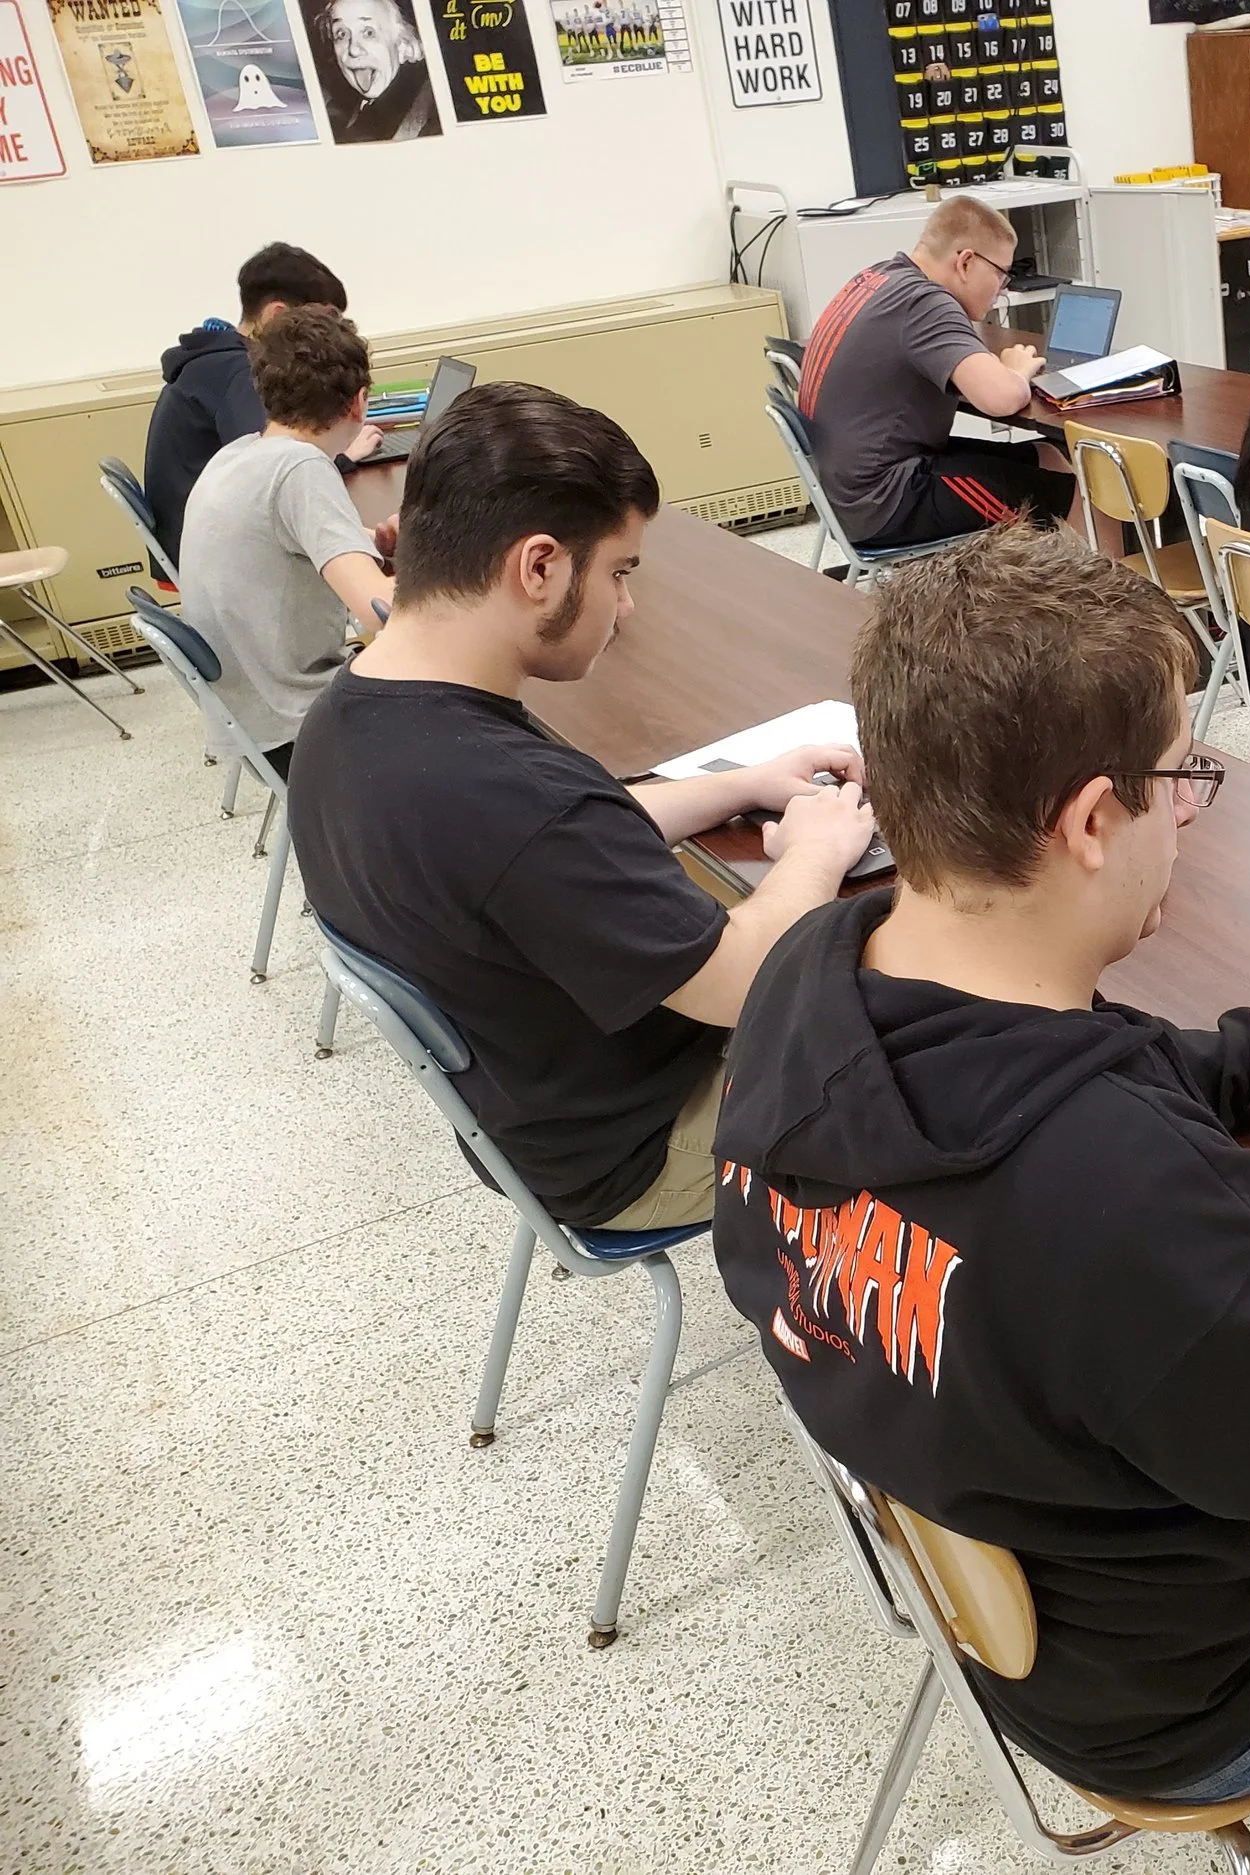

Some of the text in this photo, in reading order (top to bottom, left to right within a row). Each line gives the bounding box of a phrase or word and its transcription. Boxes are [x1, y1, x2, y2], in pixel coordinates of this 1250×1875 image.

[67, 0, 142, 21] WANTED
[730, 0, 798, 27] WITH
[895, 2, 911, 18] 07
[734, 31, 803, 61] HARD
[901, 48, 916, 65] 13
[929, 44, 945, 62] 14
[957, 42, 971, 59] 15
[984, 40, 999, 57] 16
[1038, 35, 1053, 51] 18
[473, 52, 506, 72] BE
[464, 72, 524, 95] WITH
[736, 63, 812, 94] WORK
[475, 93, 522, 115] YOU
[908, 92, 923, 109] 19
[936, 90, 952, 107] 20
[964, 87, 978, 103] 21
[986, 83, 1002, 100] 22
[1043, 79, 1059, 95] 24
[914, 122, 1064, 153] 25 26 27 28 29 30
